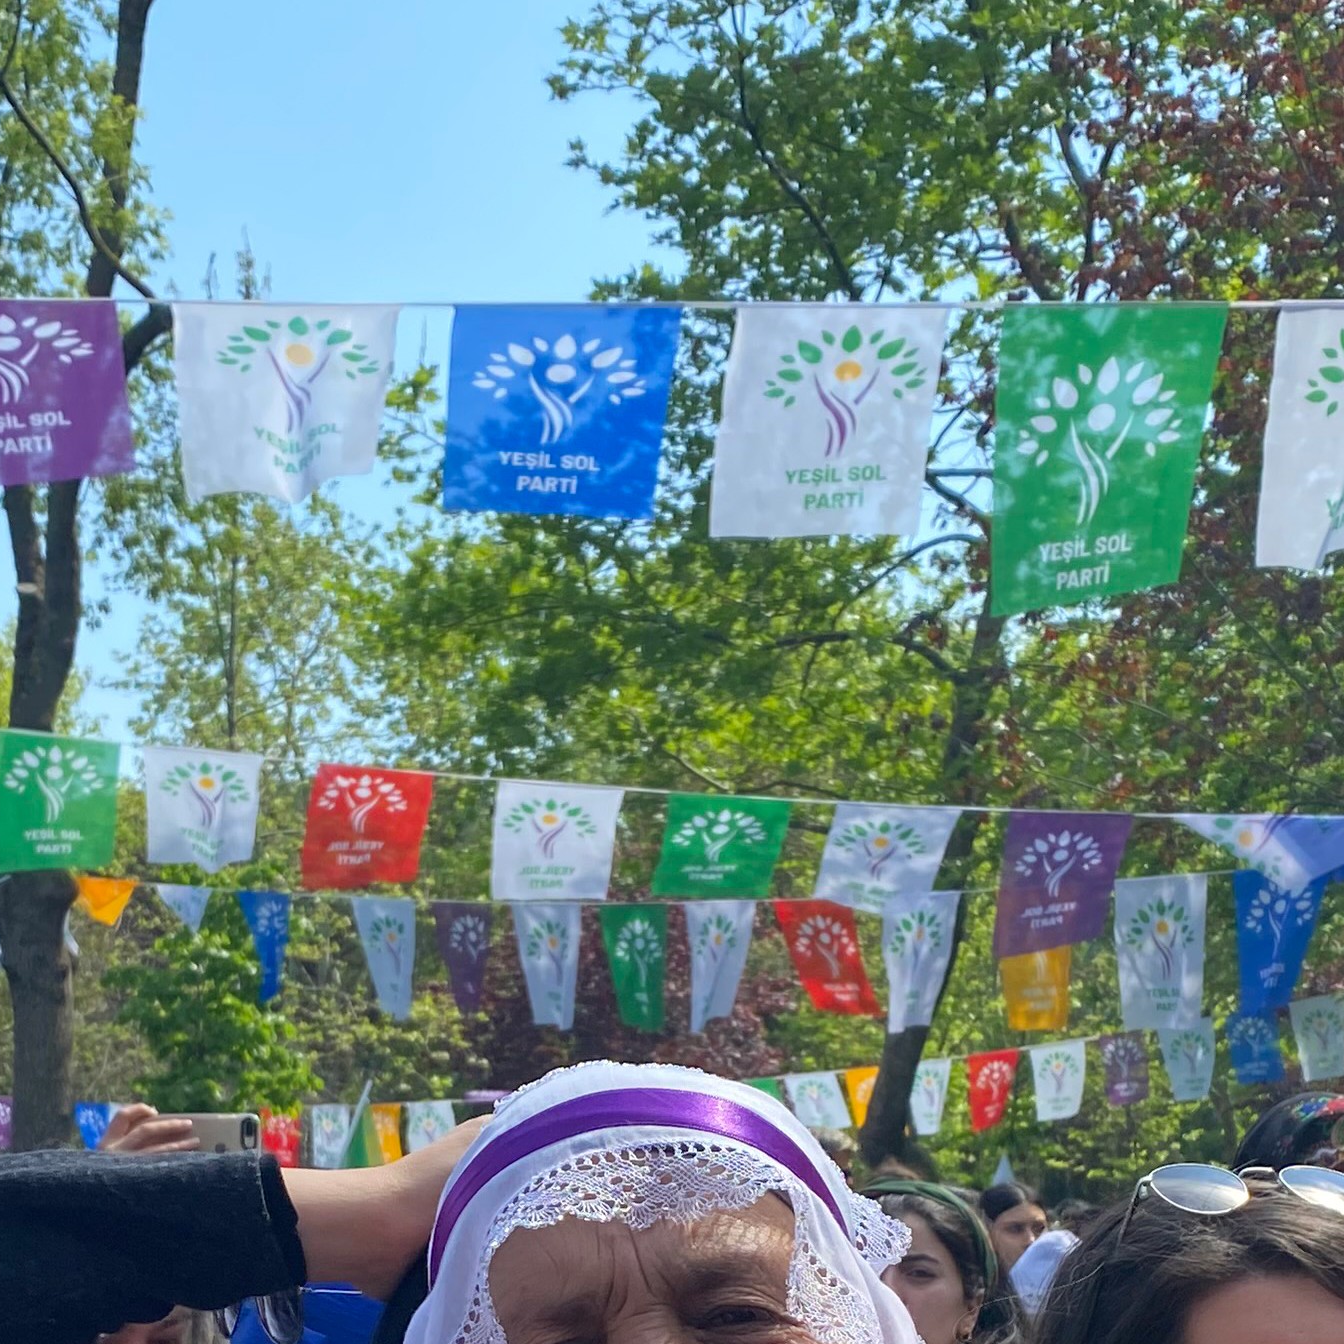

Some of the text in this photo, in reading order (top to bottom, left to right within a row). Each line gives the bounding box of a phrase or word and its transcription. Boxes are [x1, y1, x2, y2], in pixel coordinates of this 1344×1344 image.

[29, 410, 72, 427] SOL
[499, 451, 601, 472] YEŞİL SOL
[516, 475, 578, 494] PARTİ
[785, 463, 887, 486] YEŞİL SOL
[803, 486, 864, 511] PARTİ
[1039, 533, 1132, 563] YEŞİL SOL
[1056, 560, 1110, 591] PARTİ
